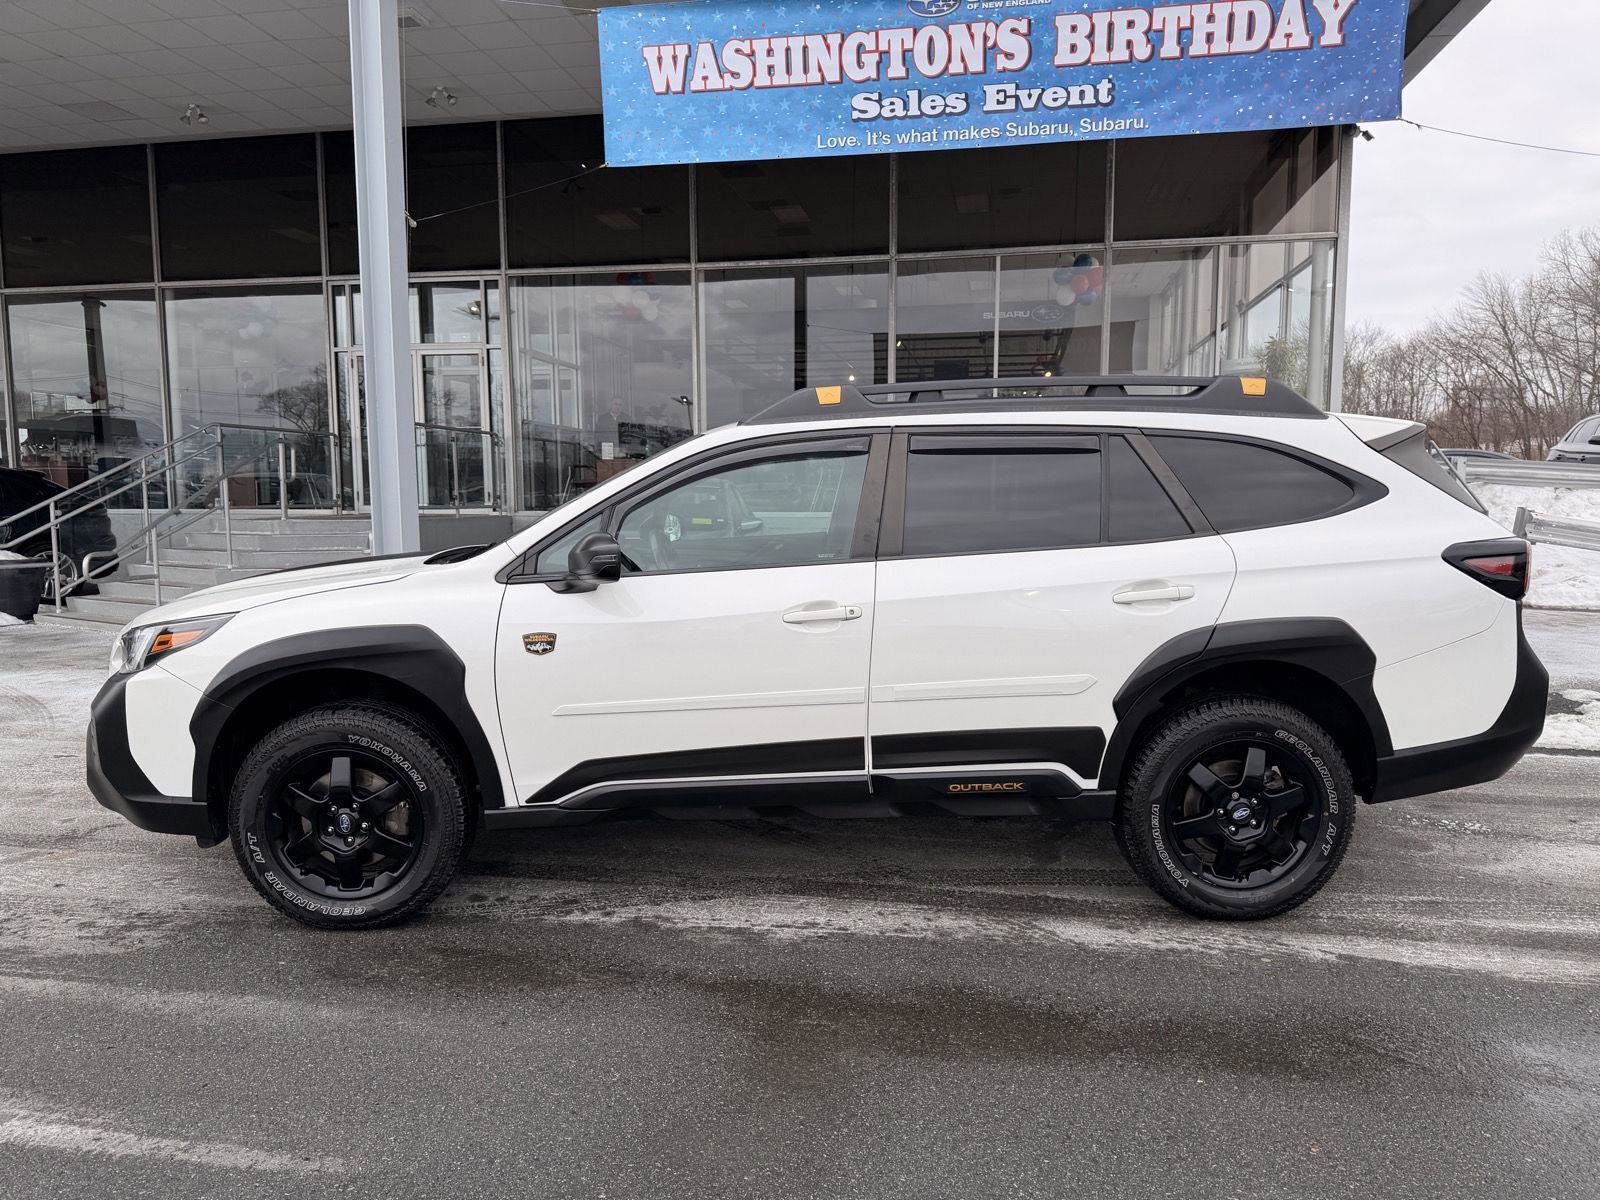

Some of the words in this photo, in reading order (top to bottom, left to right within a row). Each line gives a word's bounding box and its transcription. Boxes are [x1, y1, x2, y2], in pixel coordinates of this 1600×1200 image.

[982, 1, 1003, 9] NEW
[642, 18, 1031, 95] WASHINGTON'S
[1053, 0, 1354, 67] BIRTHDAY
[851, 89, 968, 121] Sales
[982, 78, 1114, 114] Event
[817, 134, 861, 149] Love.
[866, 130, 892, 146] It's
[897, 128, 939, 144] what
[943, 125, 1001, 141] makes
[1006, 122, 1074, 136] Subaru,
[1079, 117, 1149, 133] Subaru.
[347, 734, 428, 792] YOKOHAMA
[949, 782, 1024, 792] OUTBACK
[1275, 729, 1339, 815] GEOLANDAR
[1319, 822, 1338, 857] A/T
[247, 832, 266, 864] A/T
[1151, 804, 1190, 888] YOKOHAMA
[264, 871, 367, 916] GEOLANDAR
